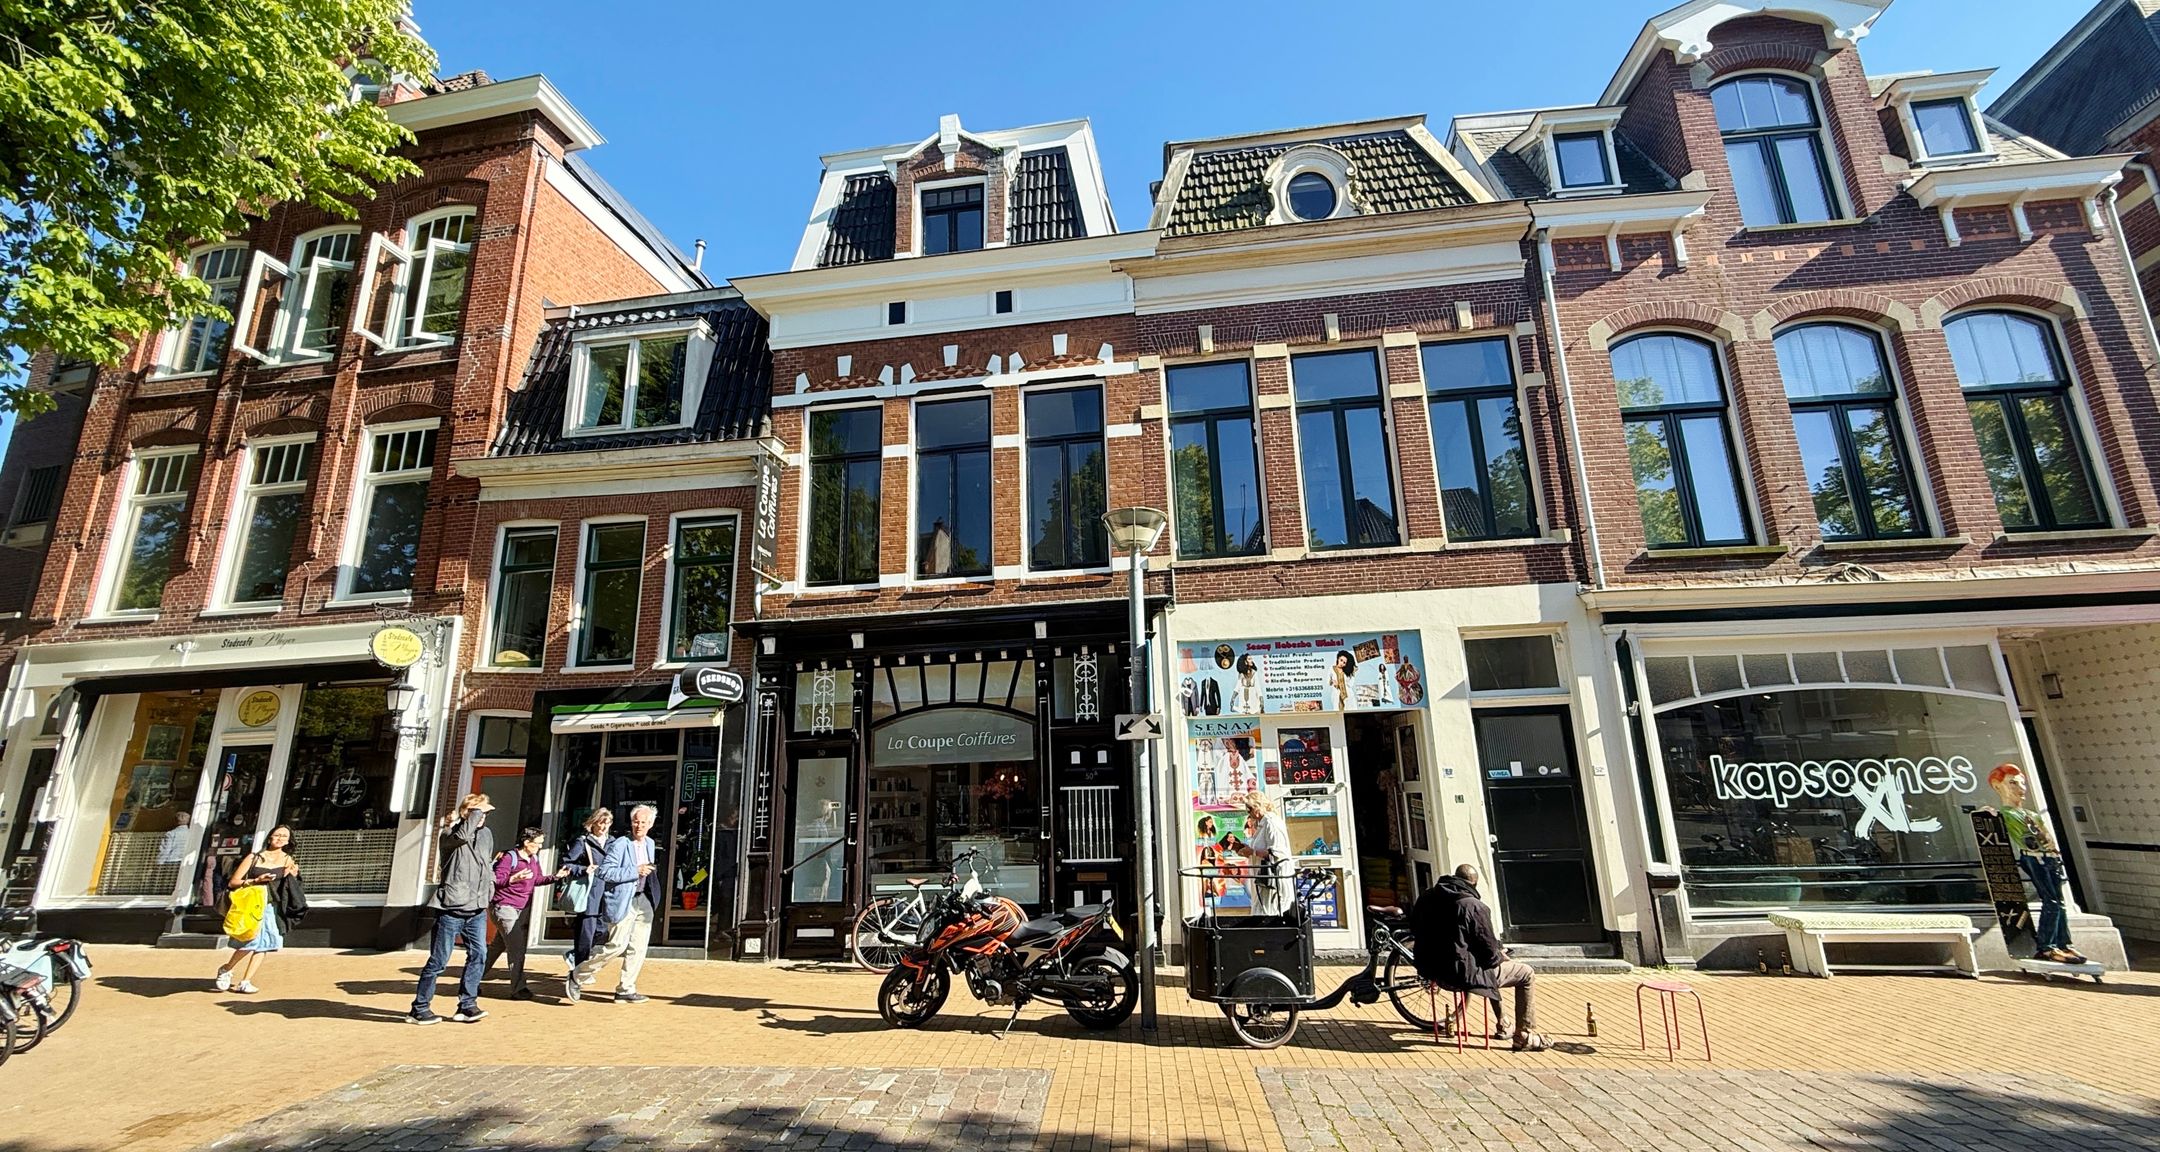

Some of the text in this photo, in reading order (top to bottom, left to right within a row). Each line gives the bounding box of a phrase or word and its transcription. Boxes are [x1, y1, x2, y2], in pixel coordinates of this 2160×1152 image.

[757, 464, 771, 539] La Coupe
[767, 475, 778, 539] Coiffures
[221, 637, 254, 648] Stadscafé
[1246, 643, 1271, 651] Senay
[1315, 639, 1344, 648] Winkel
[700, 674, 741, 691] SEEDSHOP
[611, 722, 635, 730] Cigarettes
[1195, 722, 1253, 731] SENAY
[887, 731, 1016, 752] La Coupe Coiffures
[684, 765, 695, 799] OPEN
[1294, 767, 1326, 783] OPEN
[1709, 754, 1978, 808] kapsoones
[1849, 773, 1944, 840] XL
[1978, 832, 2009, 846] XL
